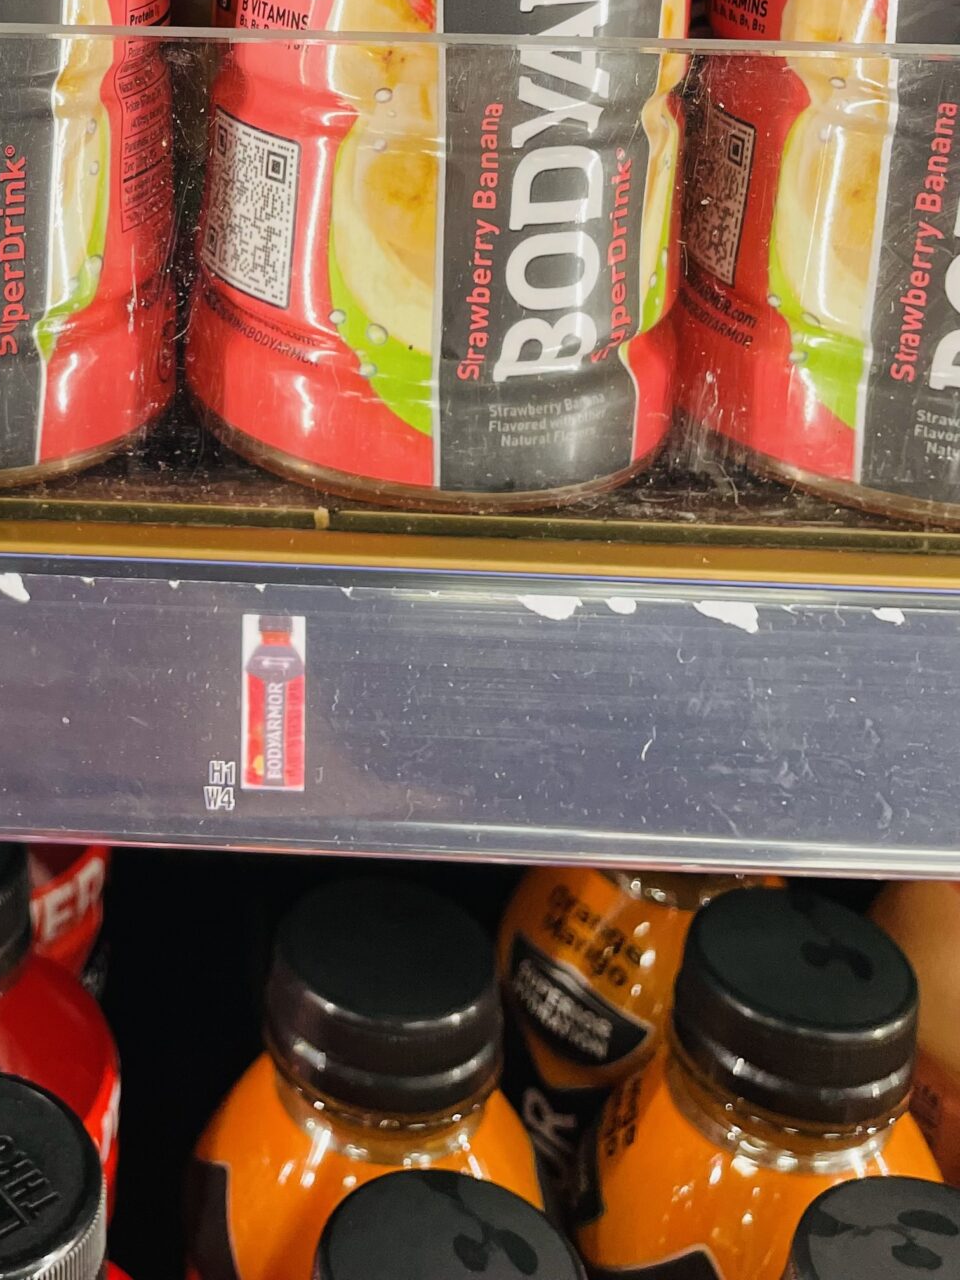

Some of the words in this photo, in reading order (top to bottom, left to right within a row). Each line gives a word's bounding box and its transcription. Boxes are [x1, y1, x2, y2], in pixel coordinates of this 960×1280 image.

[472, 102, 504, 210] Banana
[915, 101, 958, 211] Banana
[457, 218, 501, 383] Strawberry
[890, 220, 945, 384] Strawberry
[488, 402, 561, 418] Strawberry
